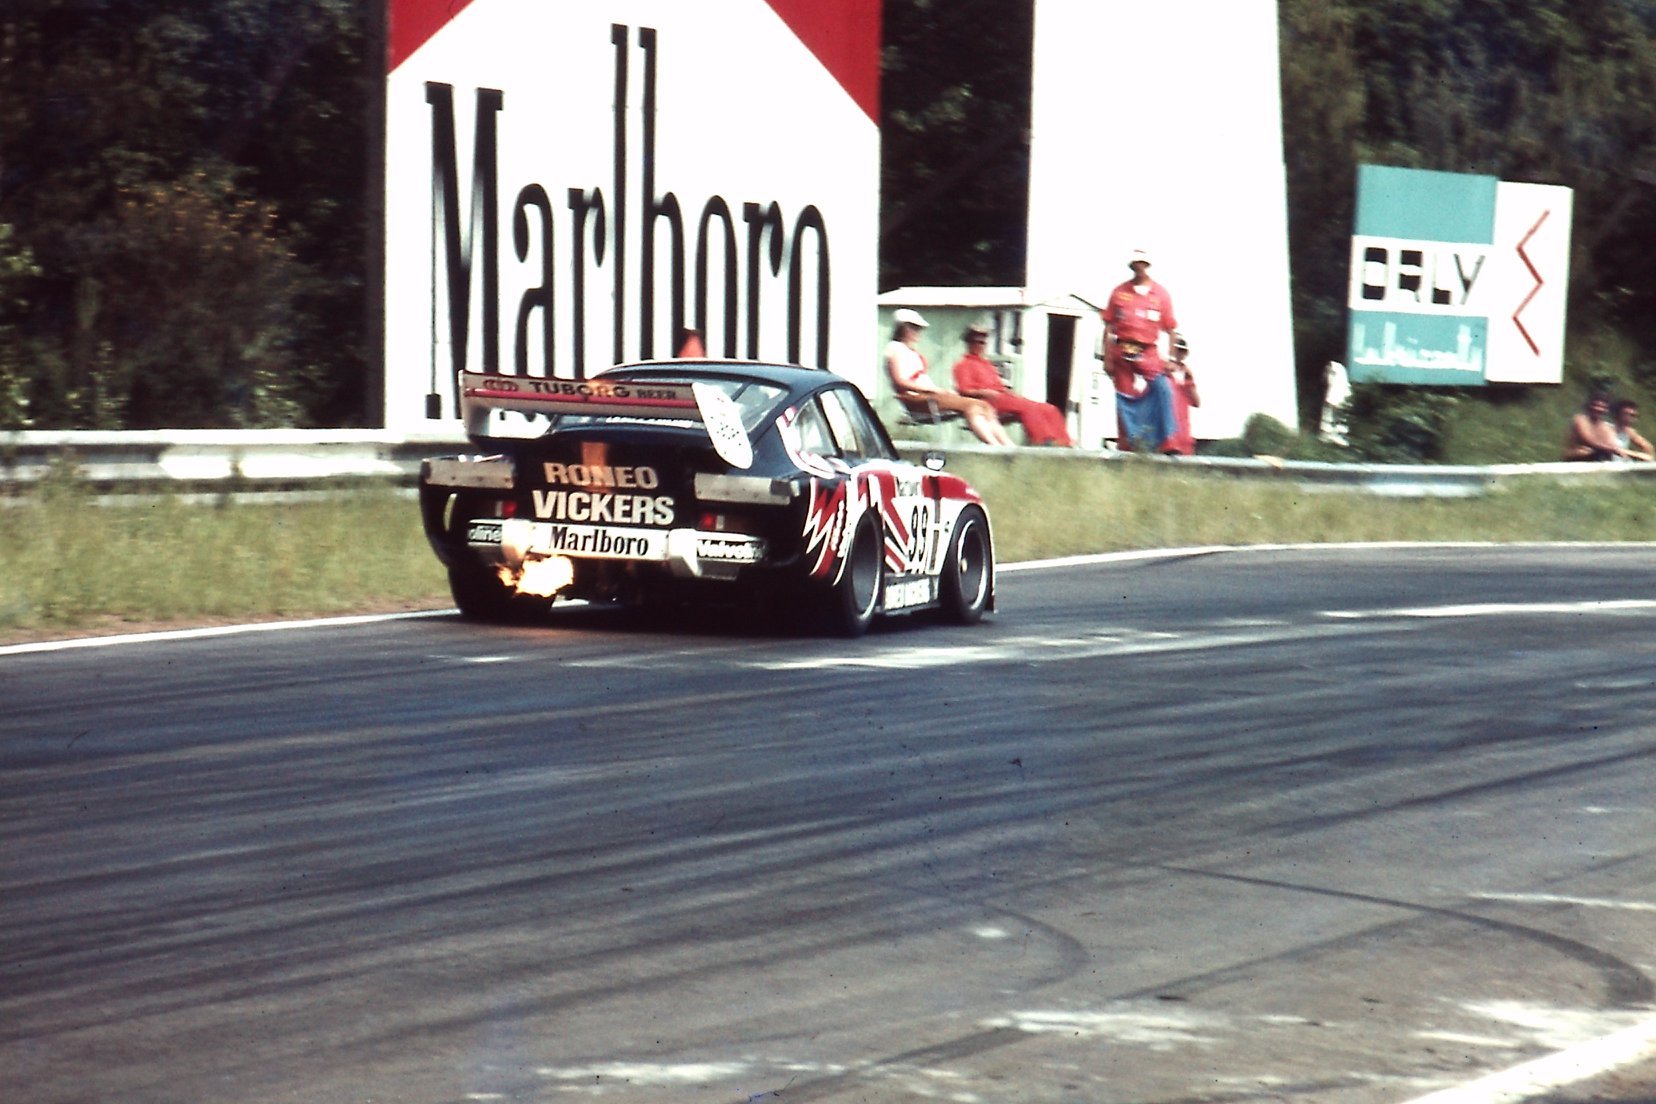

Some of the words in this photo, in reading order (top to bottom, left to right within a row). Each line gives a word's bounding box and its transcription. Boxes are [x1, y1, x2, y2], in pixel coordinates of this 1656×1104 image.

[424, 23, 830, 420] Marlboro
[528, 381, 631, 399] TUBORG
[543, 462, 659, 490] RONEO
[532, 490, 675, 526] VICKERS
[549, 525, 649, 556] Marlboro
[908, 505, 929, 562] 99
